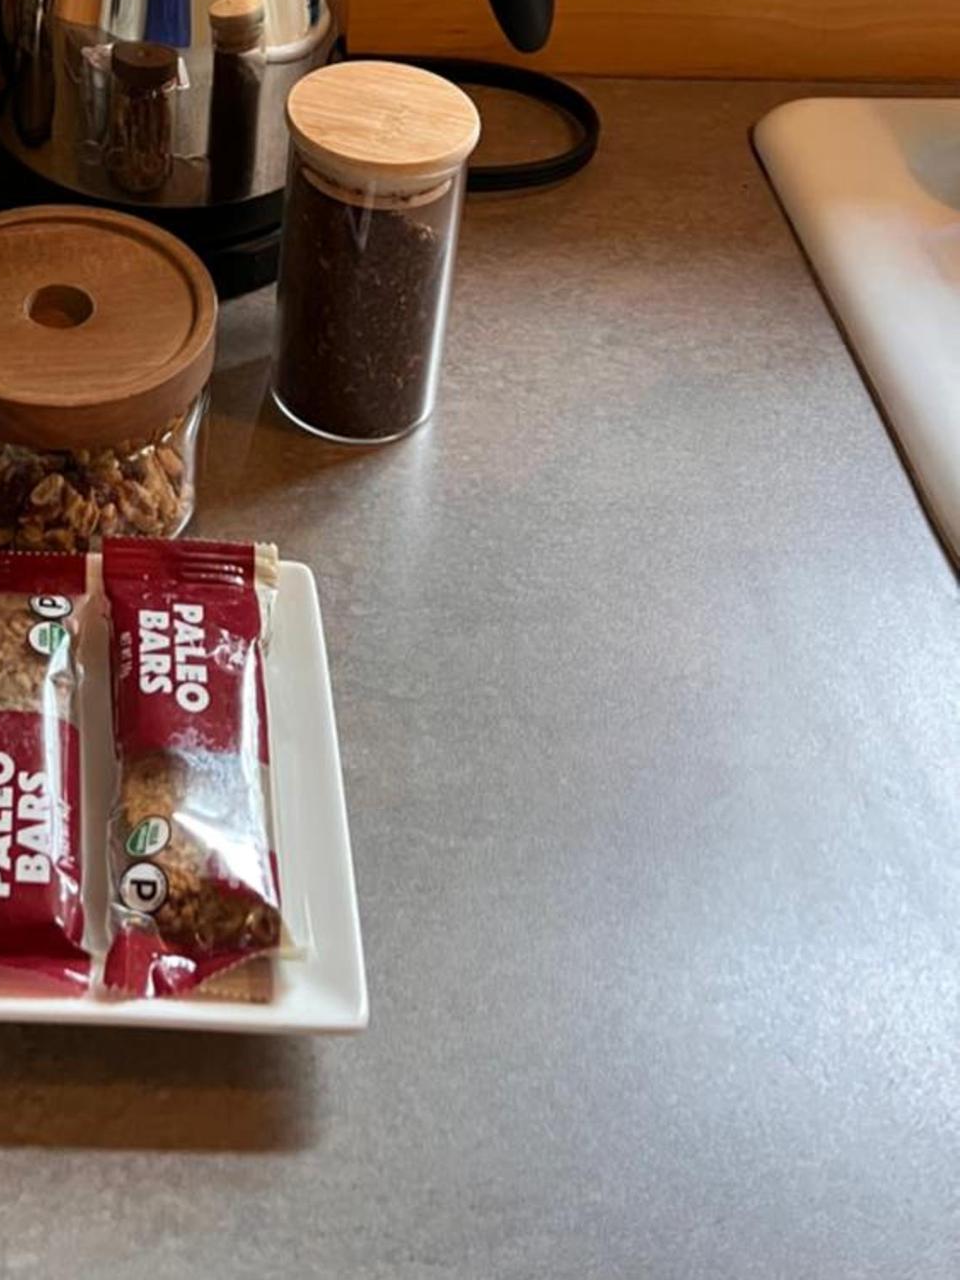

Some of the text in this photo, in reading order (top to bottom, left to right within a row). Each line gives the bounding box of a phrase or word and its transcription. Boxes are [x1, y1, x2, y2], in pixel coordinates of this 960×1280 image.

[138, 609, 174, 695] BARS
[172, 602, 211, 714] PALEO
[15, 771, 52, 885] BARS
